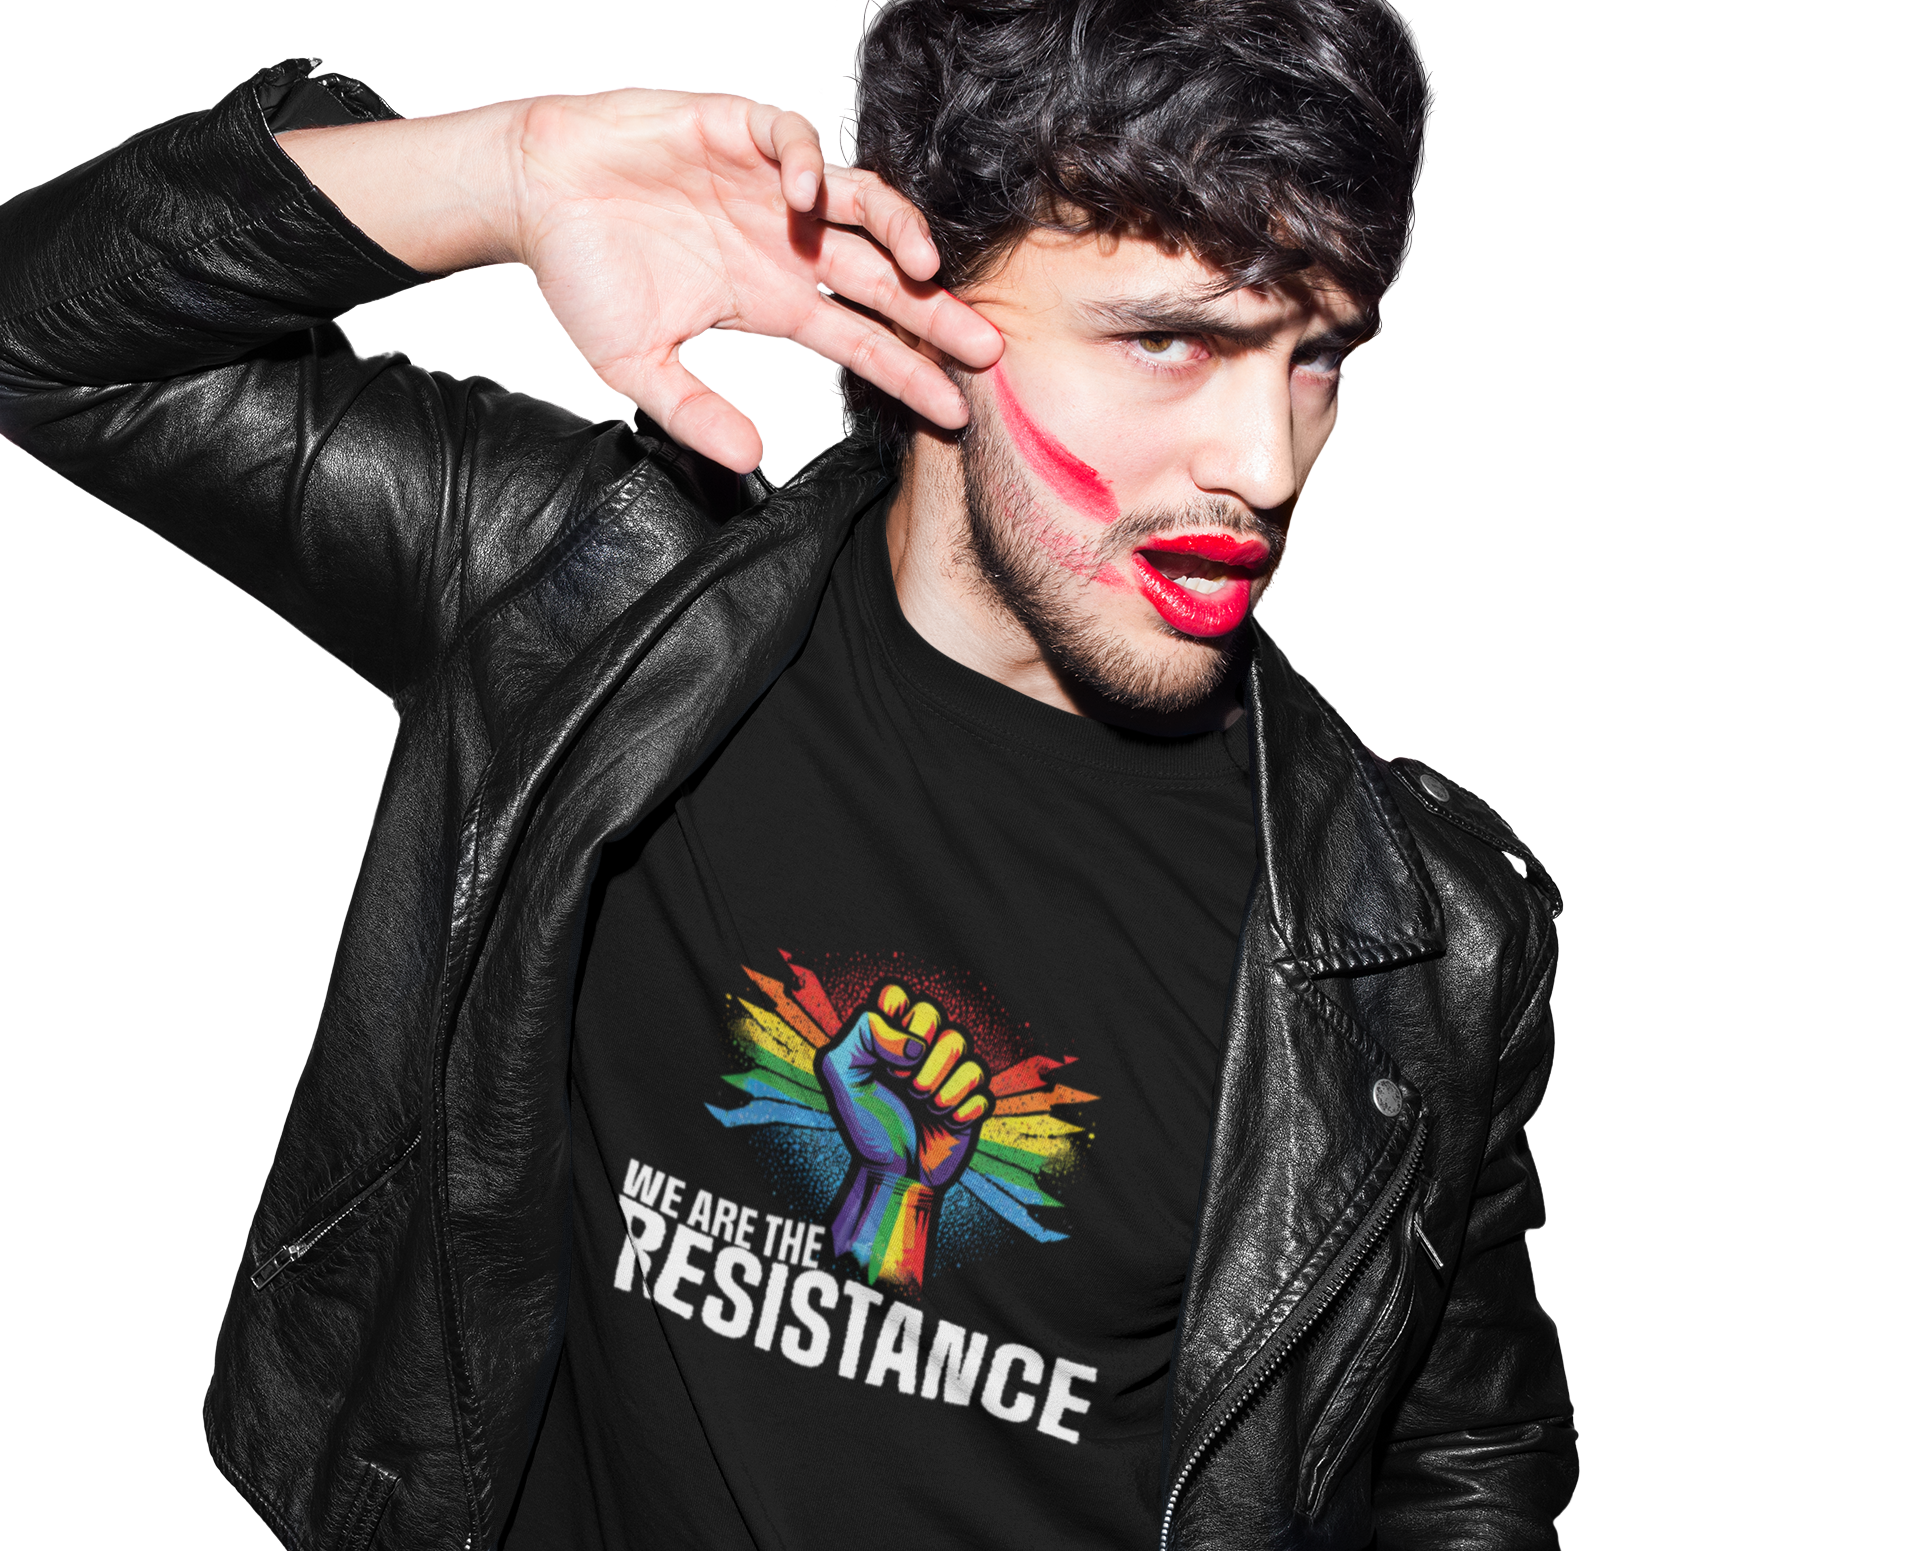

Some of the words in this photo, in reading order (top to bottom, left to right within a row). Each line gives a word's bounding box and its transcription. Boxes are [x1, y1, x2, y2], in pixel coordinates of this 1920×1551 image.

[622, 1158, 686, 1218] WE
[687, 1189, 758, 1250] ARE
[763, 1214, 826, 1269] THE
[614, 1194, 1098, 1444] RESISTANCE
